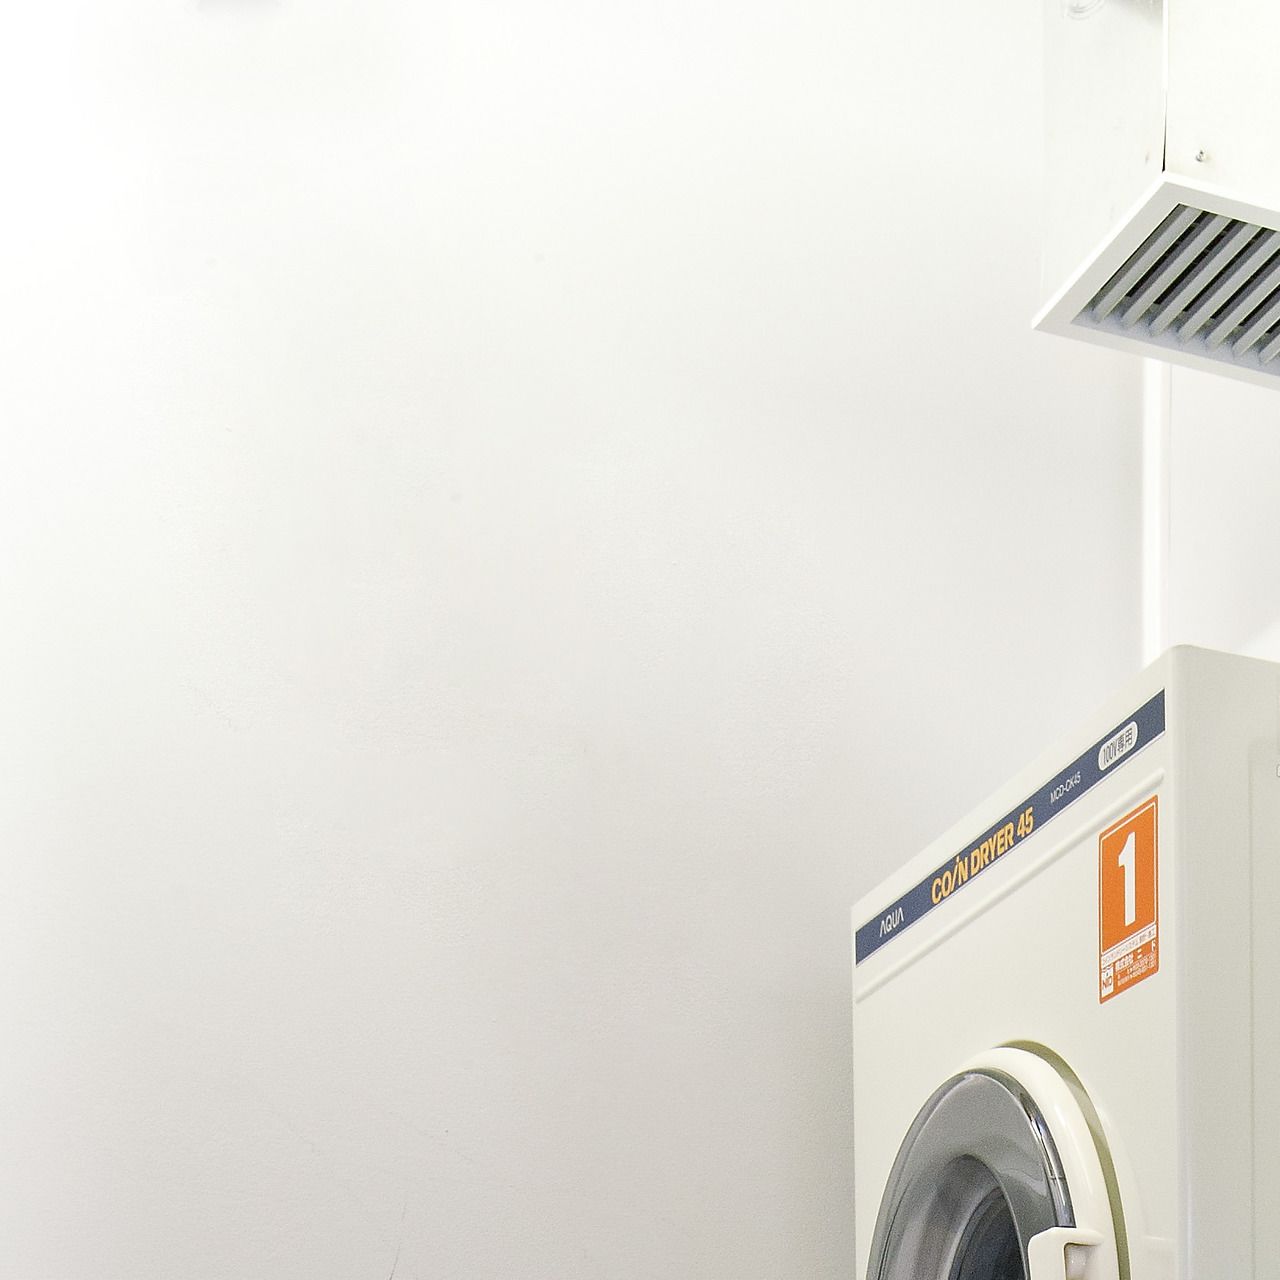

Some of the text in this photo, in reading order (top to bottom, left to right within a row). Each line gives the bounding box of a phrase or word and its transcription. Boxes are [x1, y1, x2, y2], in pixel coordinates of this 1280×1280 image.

[1101, 726, 1133, 766] 100V専用
[970, 822, 1014, 882] DRYER
[1016, 806, 1034, 840] 45
[1117, 831, 1136, 928] 1
[879, 906, 905, 938] AQUA
